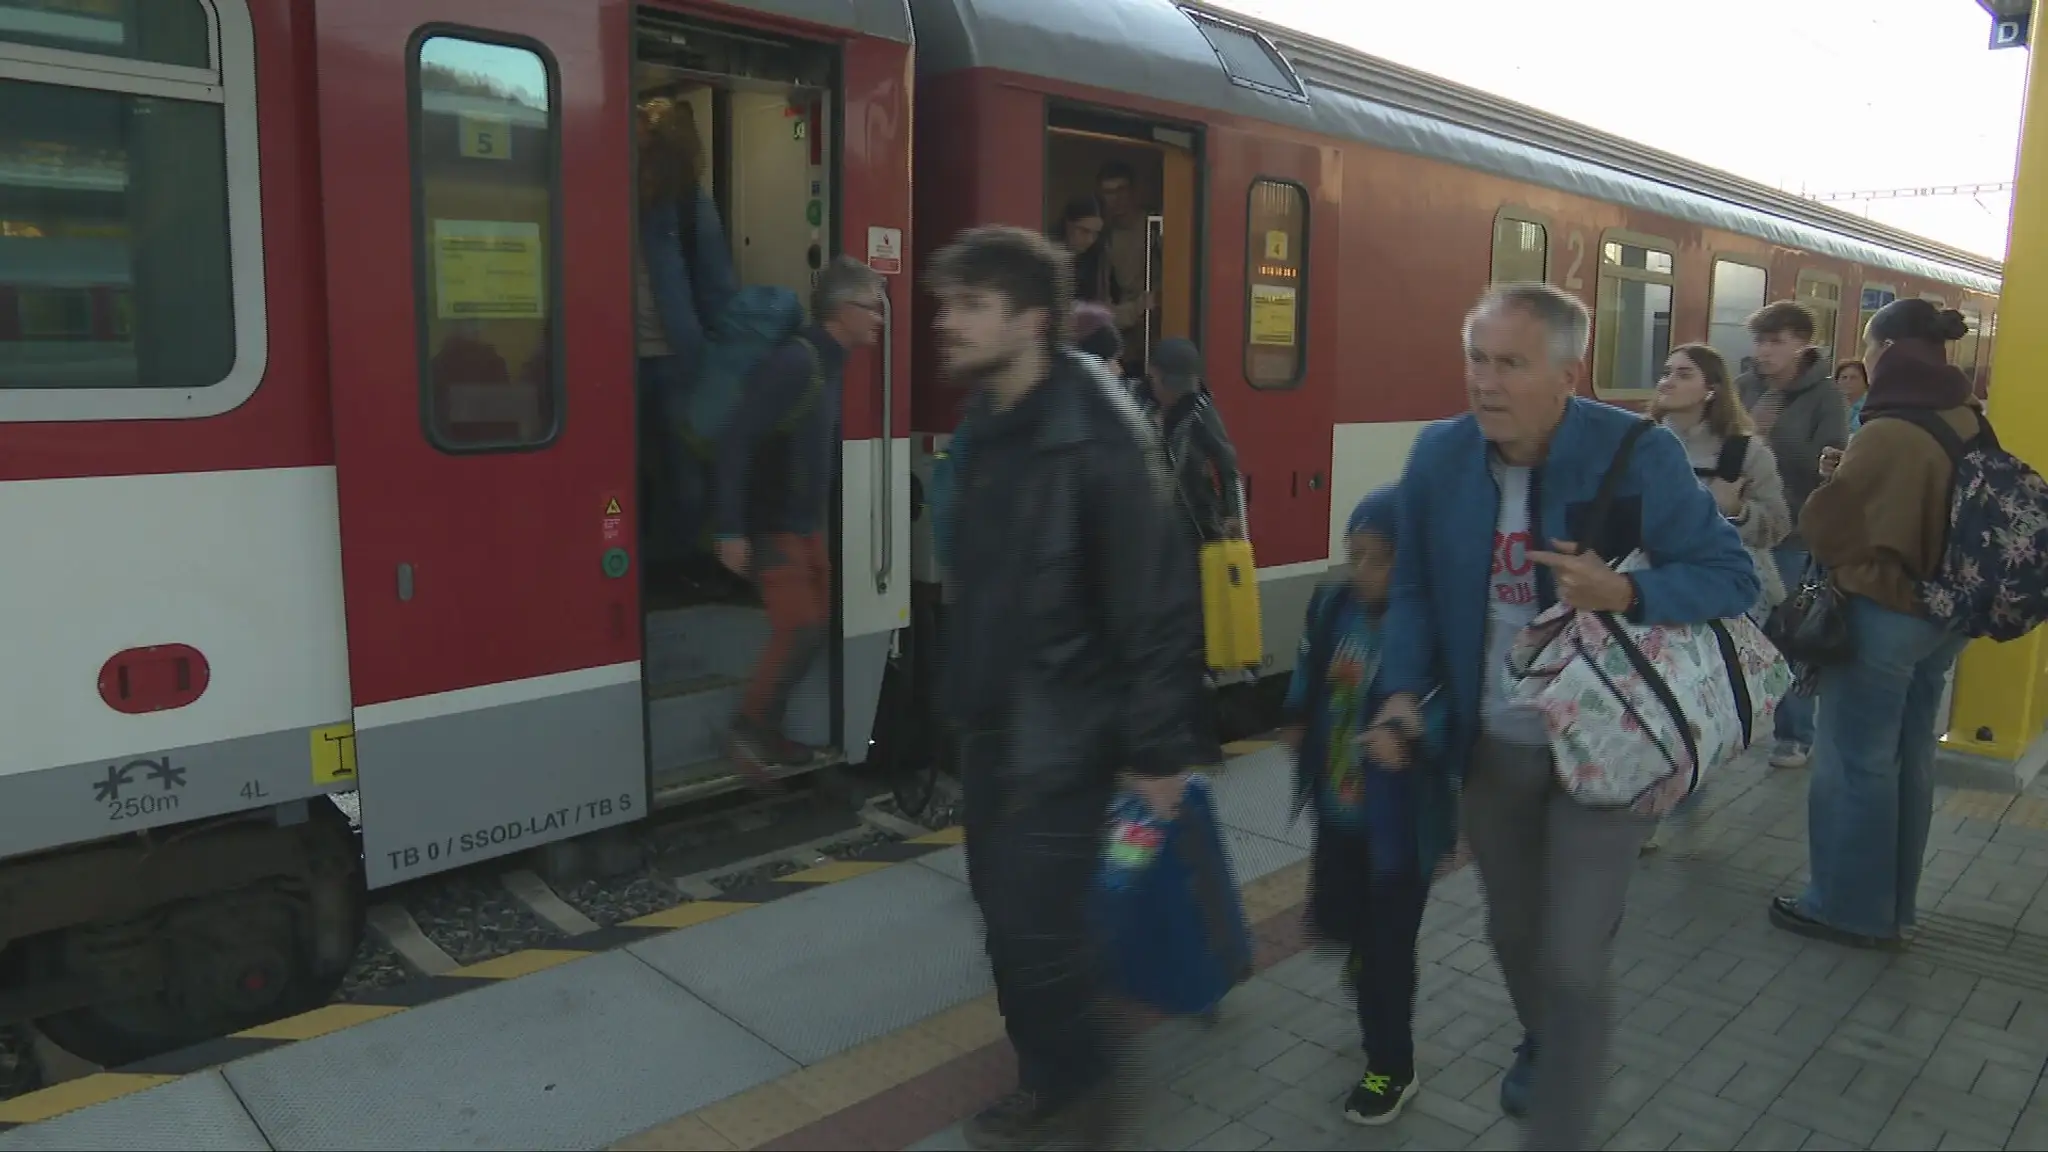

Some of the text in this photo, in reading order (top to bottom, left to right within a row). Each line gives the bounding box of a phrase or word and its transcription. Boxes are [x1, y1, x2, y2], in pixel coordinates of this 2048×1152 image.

[1997, 21, 2019, 43] D
[477, 132, 493, 154] 5
[1565, 229, 1584, 289] 2
[240, 780, 268, 798] 4L
[108, 794, 179, 820] 250m
[387, 847, 420, 870] TB
[460, 808, 569, 852] SSOD-LAT
[586, 798, 613, 819] TB
[619, 793, 632, 811] S
